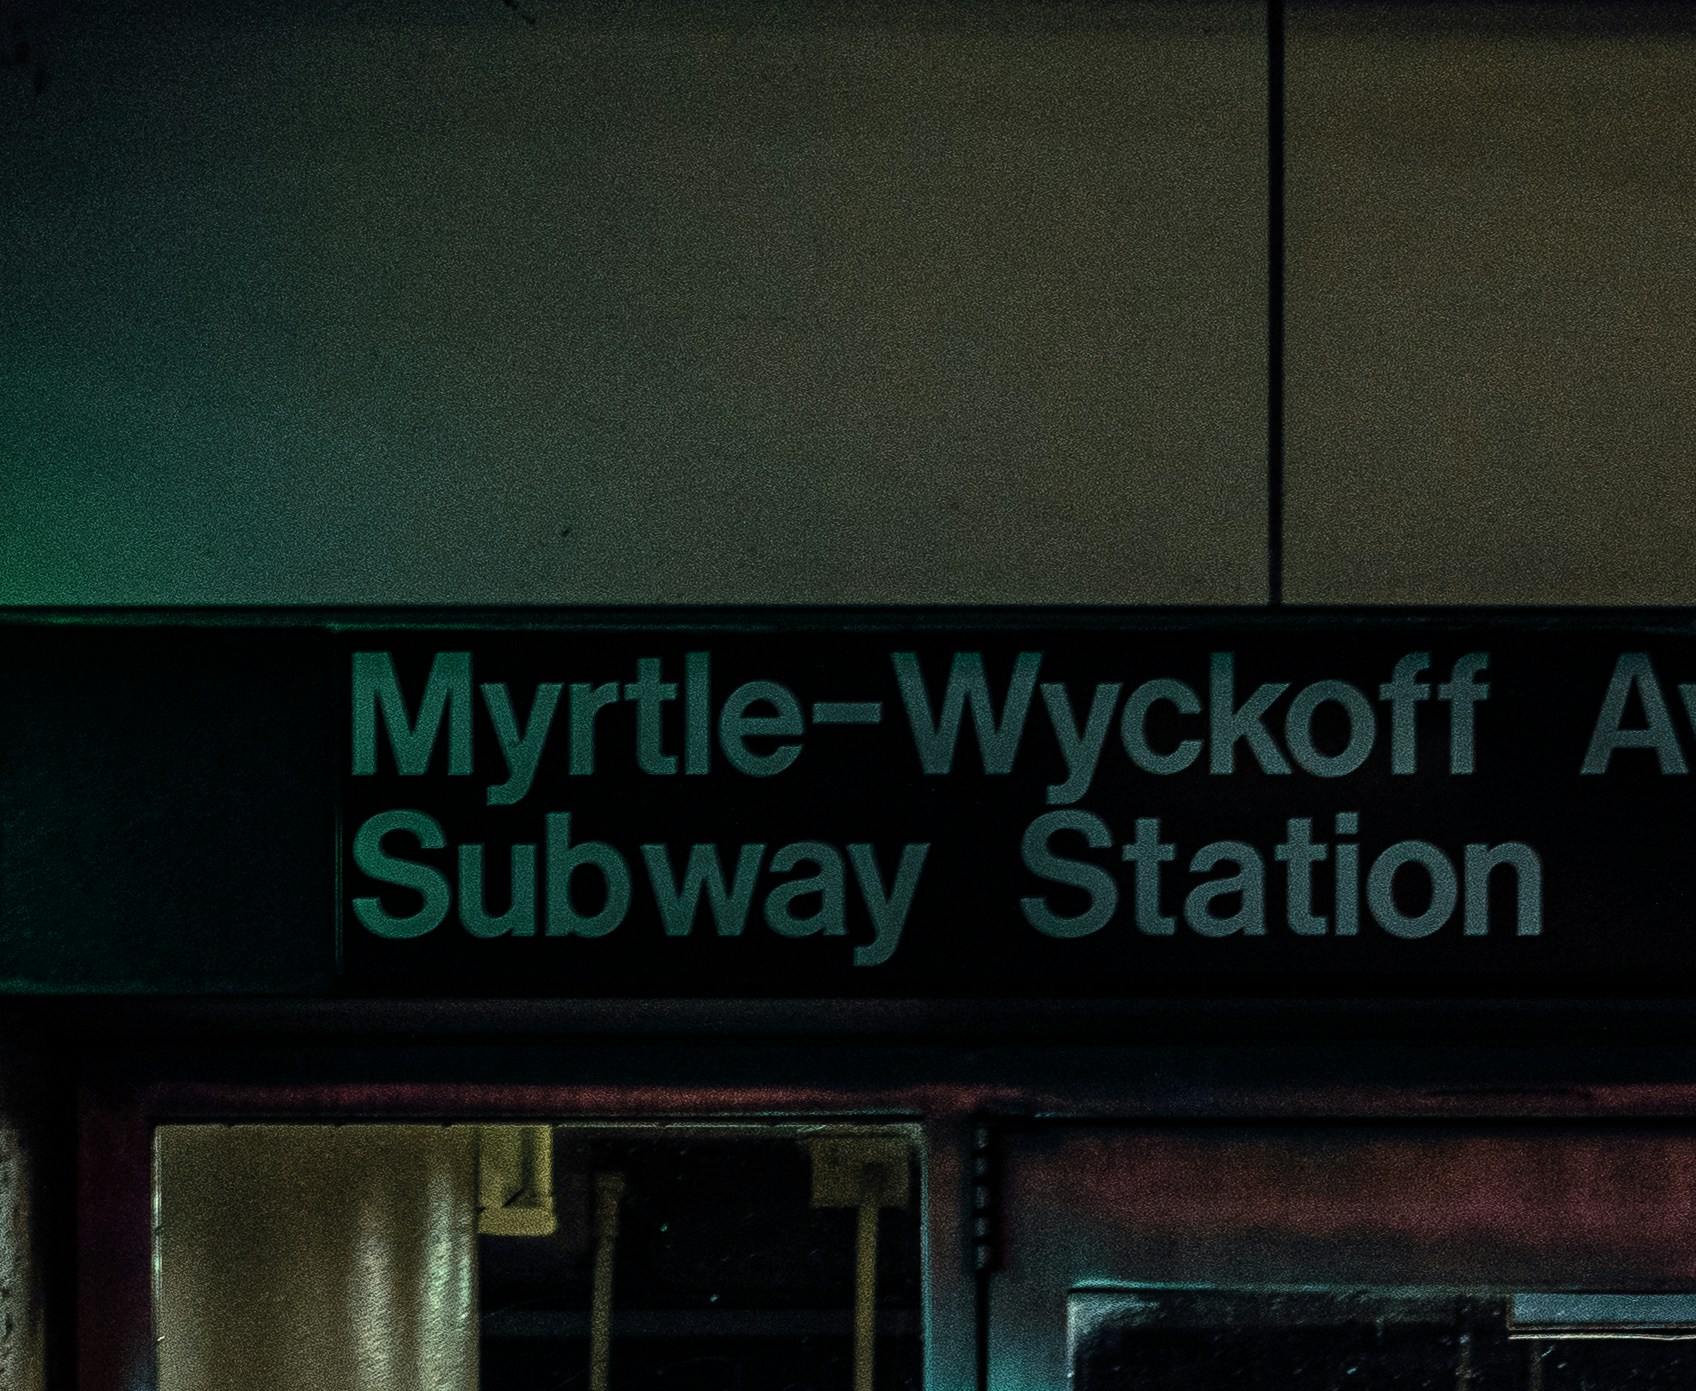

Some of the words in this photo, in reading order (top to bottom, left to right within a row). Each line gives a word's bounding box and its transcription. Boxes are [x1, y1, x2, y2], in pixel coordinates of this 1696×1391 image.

[349, 648, 1492, 804] Myrtle-Wyckoff
[349, 809, 931, 966] Subway
[1016, 810, 1545, 942] Station
